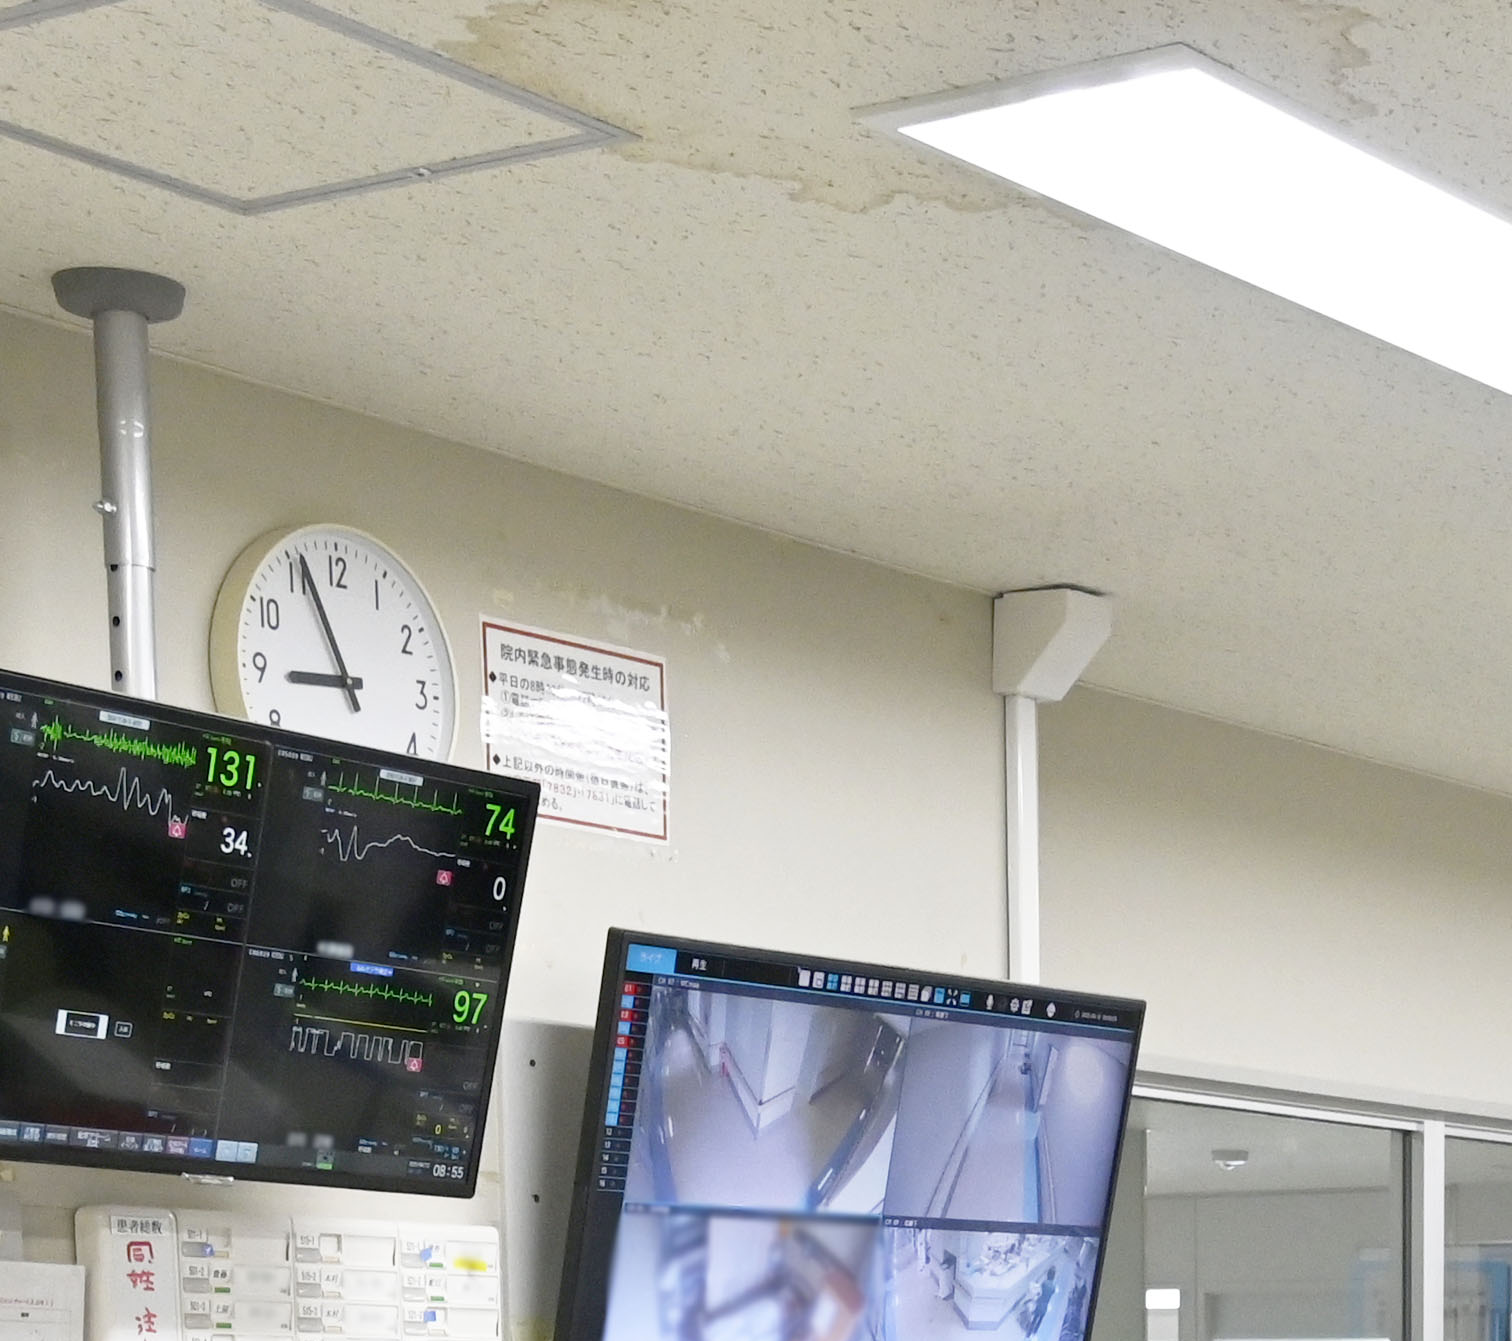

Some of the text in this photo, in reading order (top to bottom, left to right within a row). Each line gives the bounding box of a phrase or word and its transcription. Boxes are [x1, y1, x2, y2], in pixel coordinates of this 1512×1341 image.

[329, 556, 348, 590] 12
[374, 579, 380, 612] 1
[260, 597, 281, 631] 10
[401, 625, 414, 656] 2
[252, 651, 268, 684] 9
[499, 642, 651, 693] 院内緊急事態発生時の対応
[415, 680, 429, 711] 3
[405, 732, 419, 757] 4
[207, 746, 256, 790] 131
[486, 803, 516, 840] 74
[220, 826, 248, 855] 34
[493, 876, 507, 901] 0
[691, 958, 707, 971] 再生
[452, 990, 488, 1025] 97
[432, 1163, 465, 1180] 08:55
[117, 1219, 163, 1234] 患者総数
